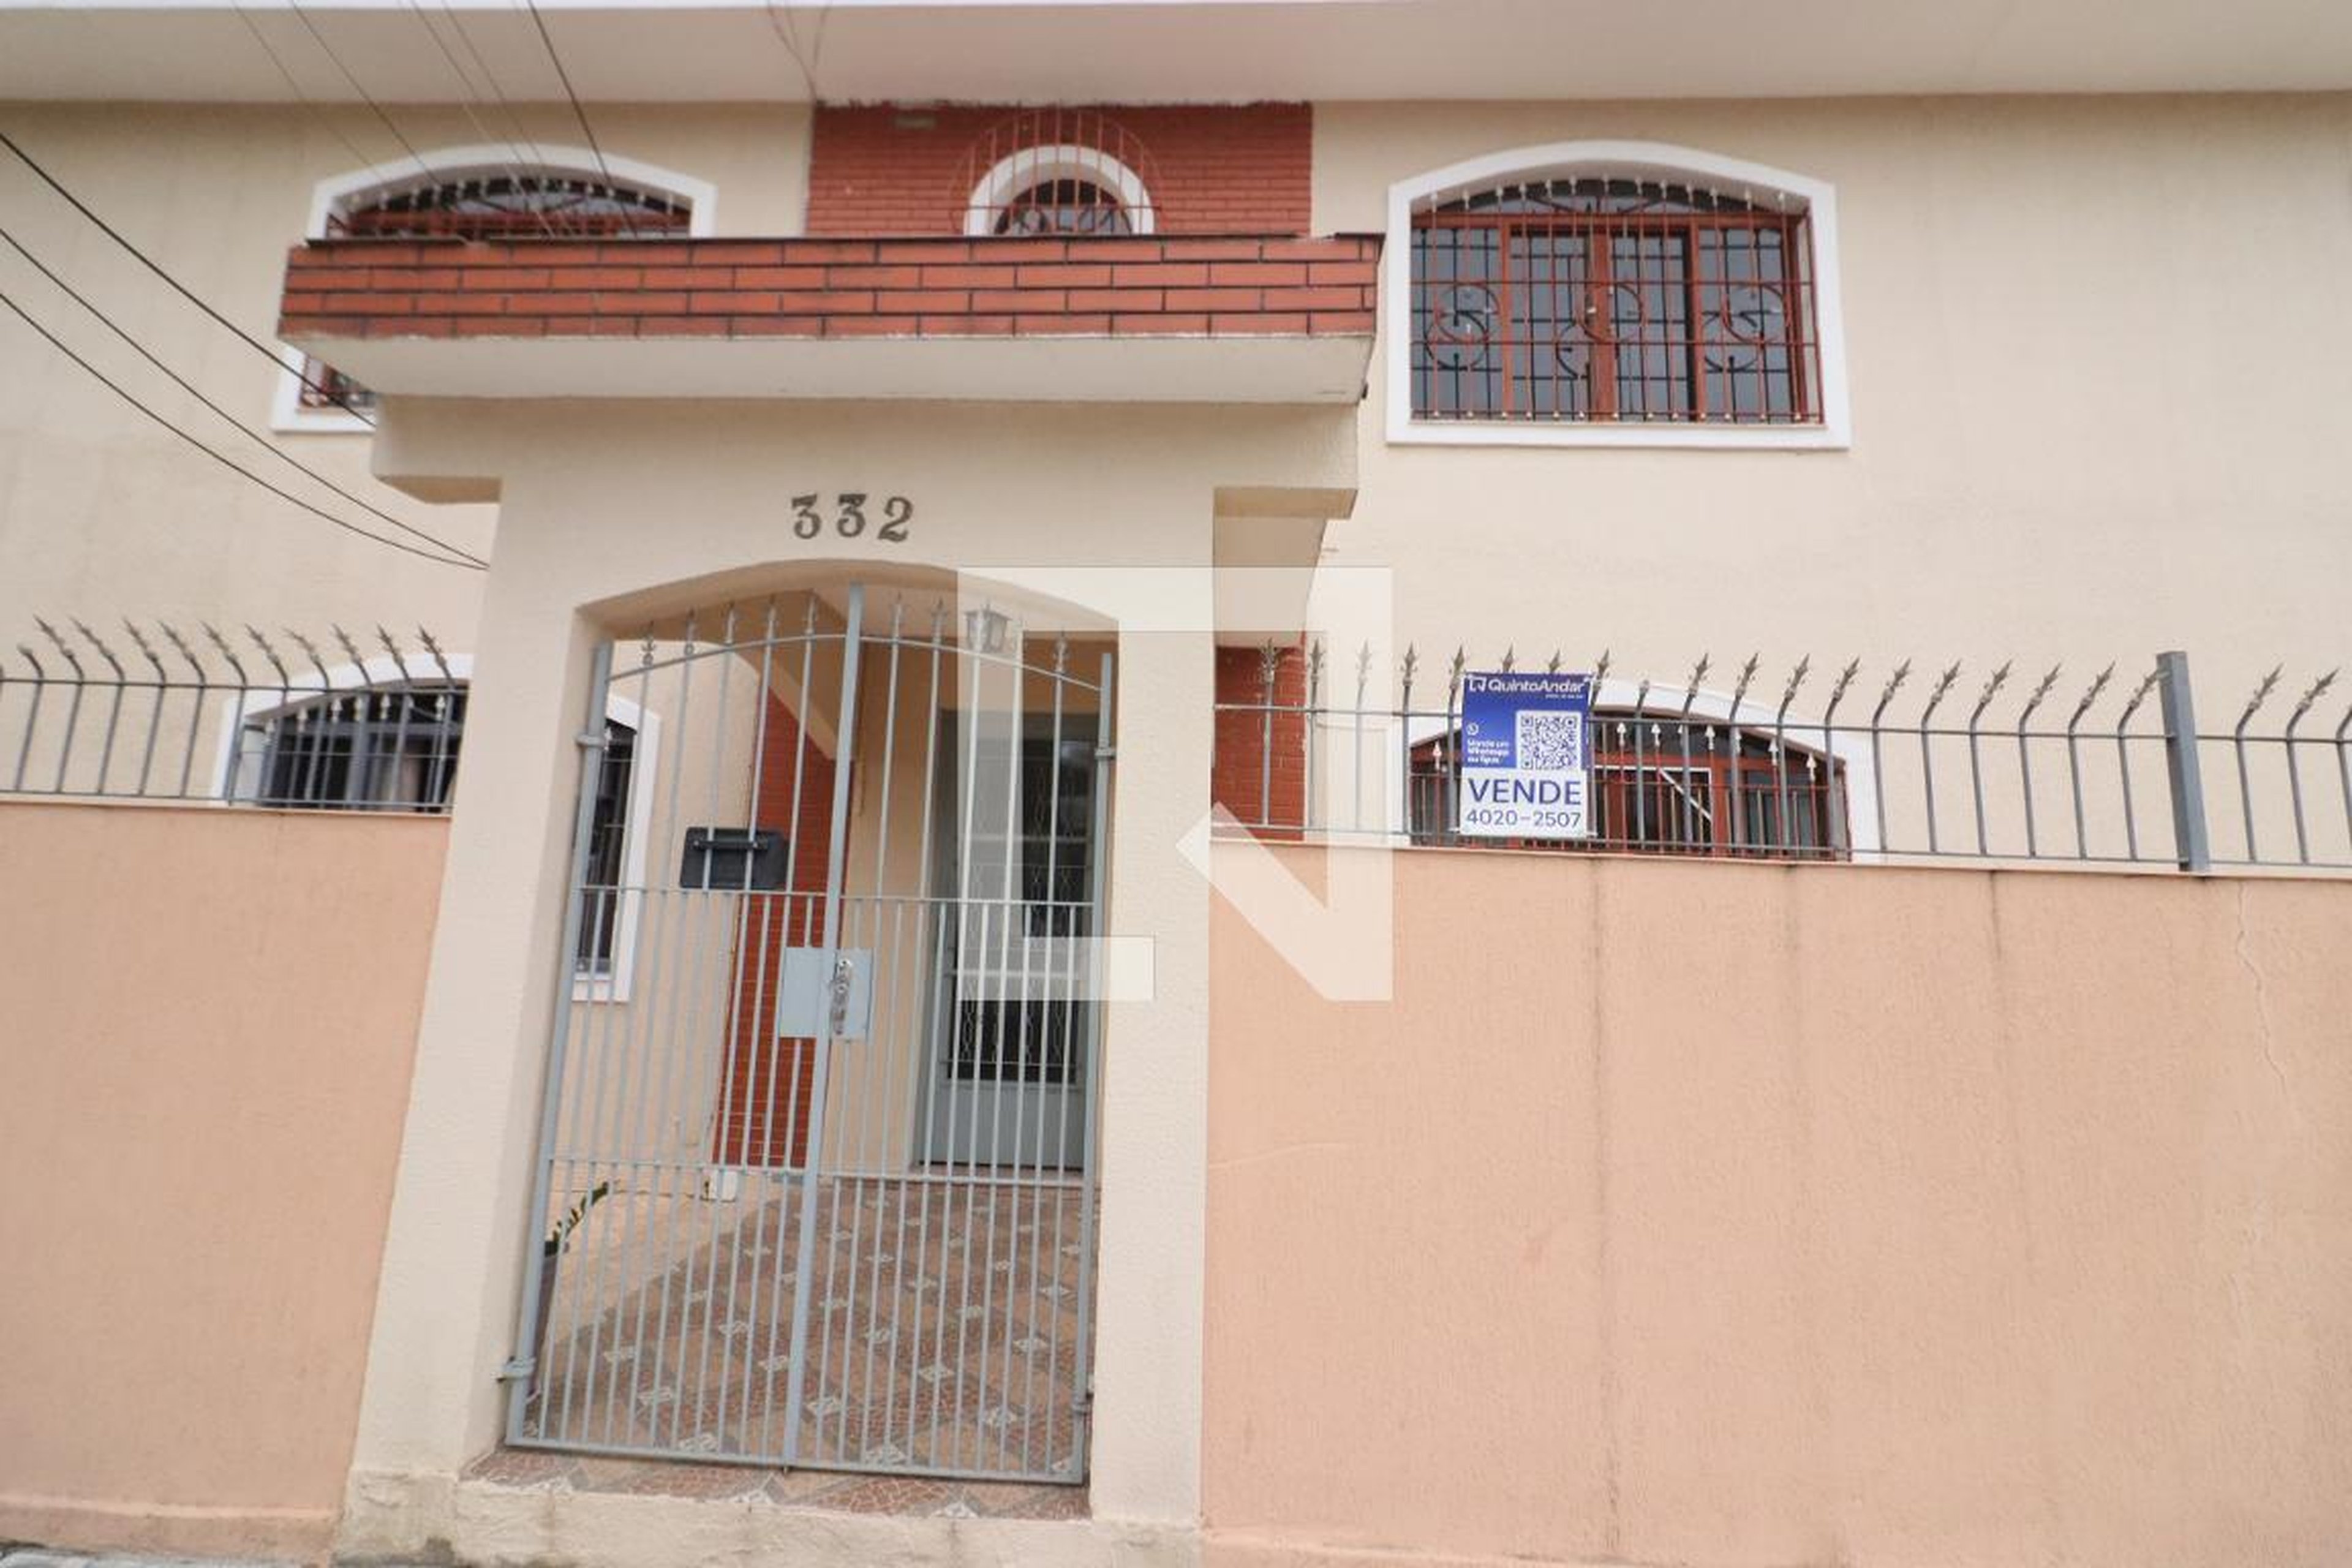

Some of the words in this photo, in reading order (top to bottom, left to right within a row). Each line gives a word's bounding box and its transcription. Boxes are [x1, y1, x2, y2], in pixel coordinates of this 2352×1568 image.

[791, 493, 913, 543] 332
[1488, 677, 1585, 693] QuintoAndar
[1468, 778, 1581, 805] VENDE
[1466, 809, 1581, 827] 4020-2507
